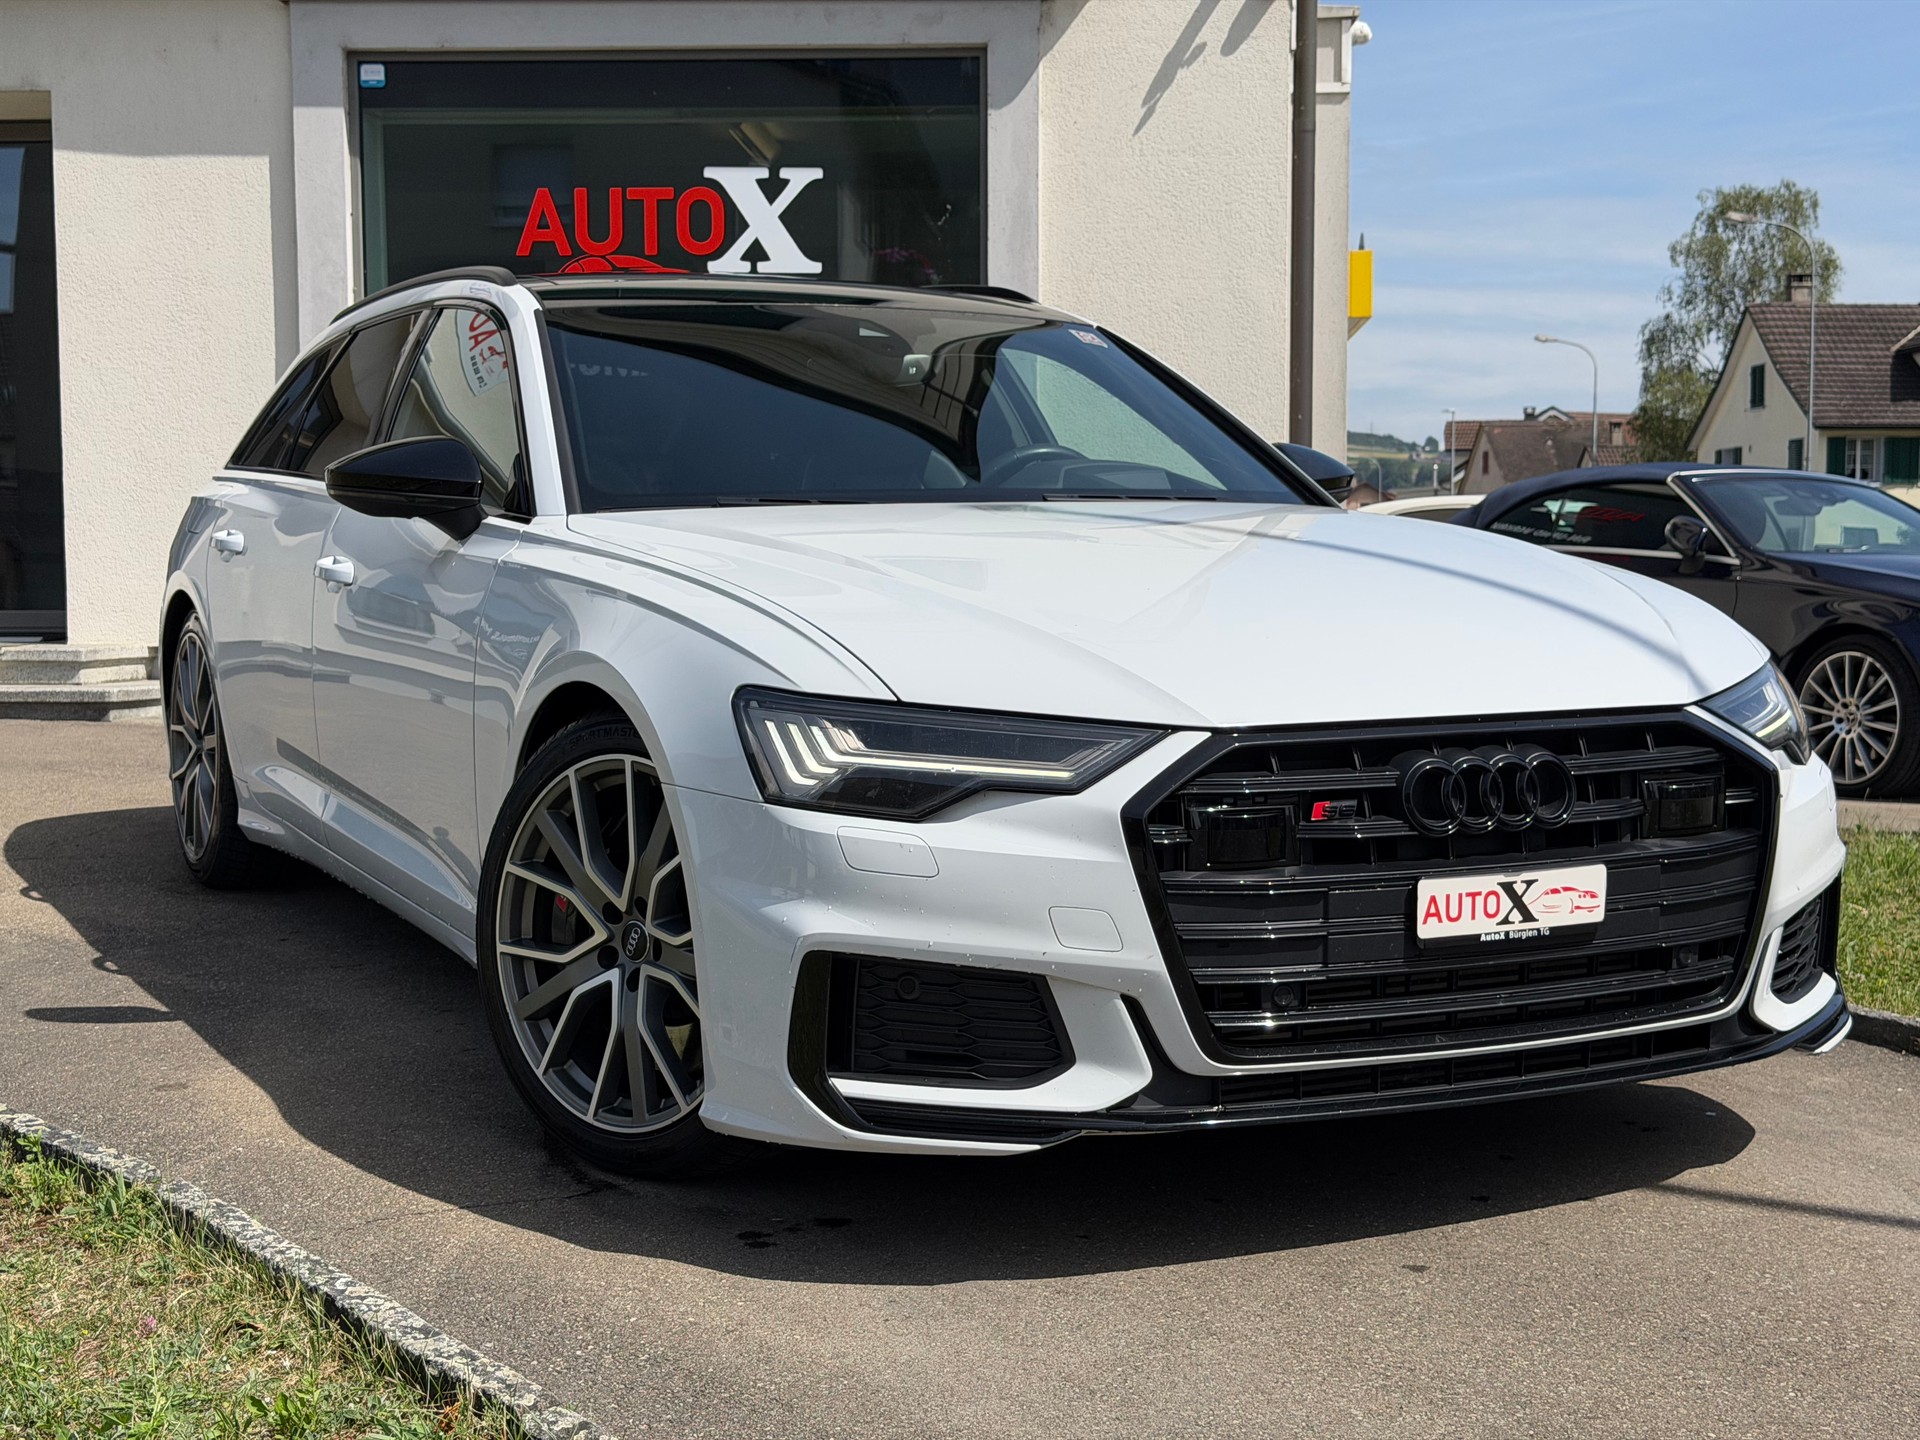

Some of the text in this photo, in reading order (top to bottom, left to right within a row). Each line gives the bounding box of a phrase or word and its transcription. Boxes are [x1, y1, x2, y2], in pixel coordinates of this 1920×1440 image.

[1480, 927, 1550, 941] AutoX Bürglen TG
